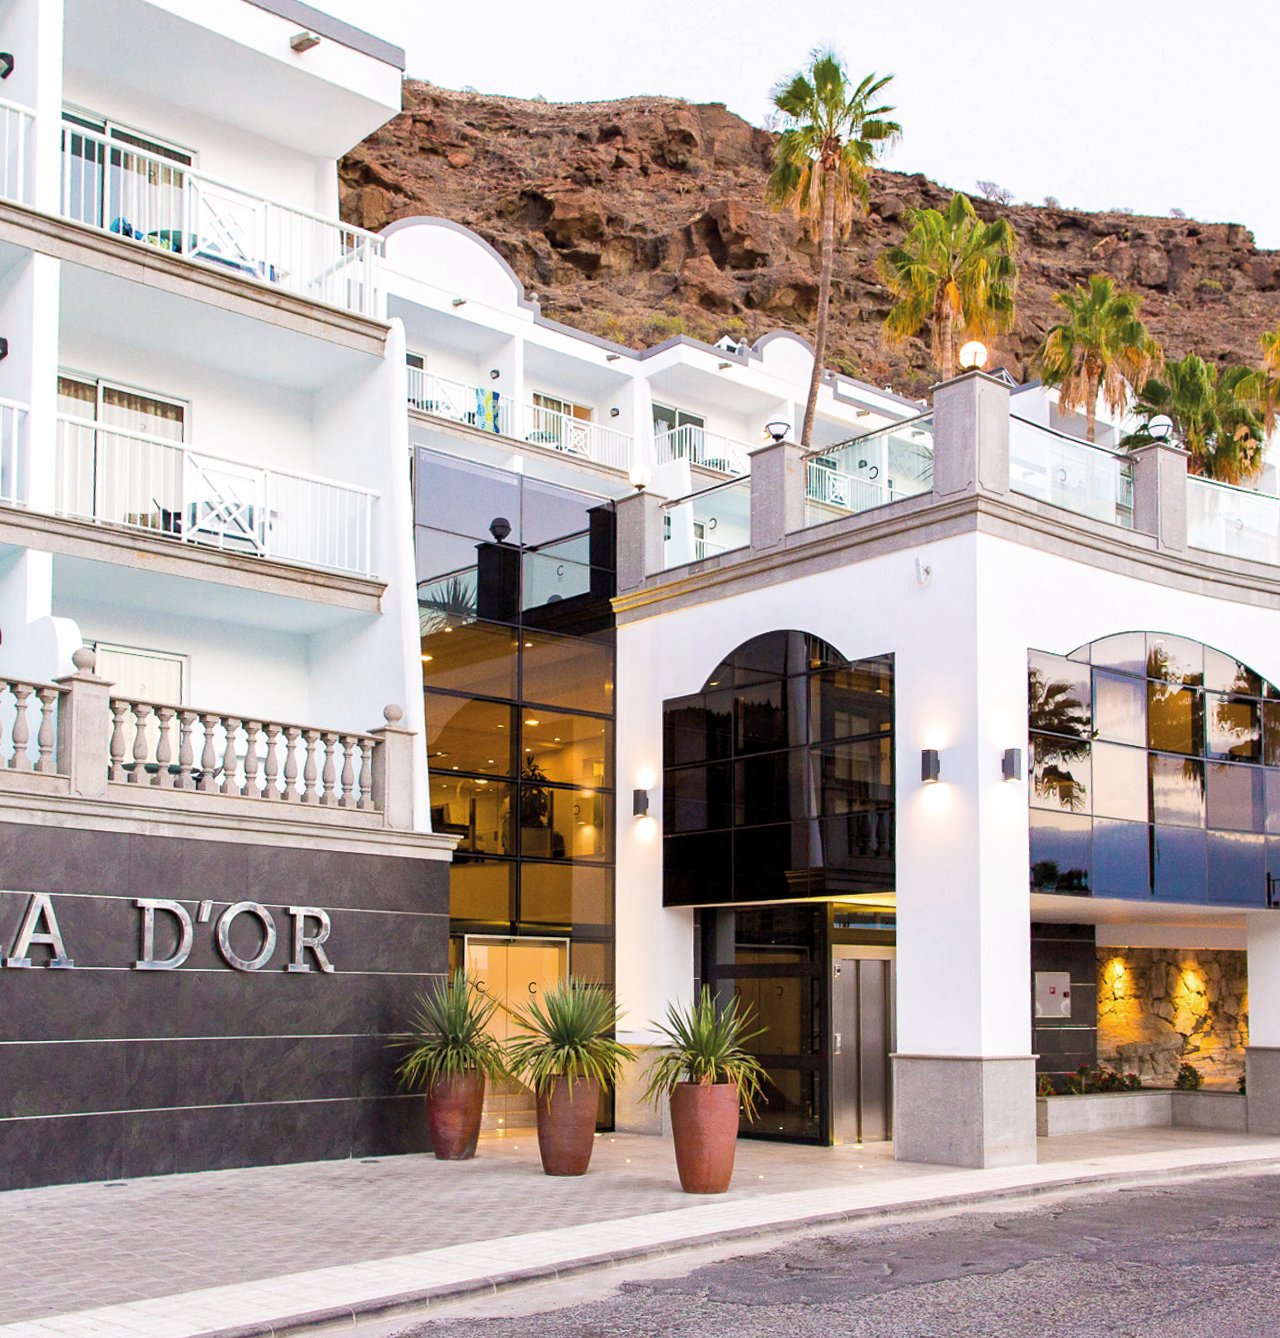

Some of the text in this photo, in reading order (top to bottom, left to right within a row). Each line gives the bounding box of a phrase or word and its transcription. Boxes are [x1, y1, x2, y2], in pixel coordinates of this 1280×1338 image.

[556, 564, 564, 577] C
[132, 898, 336, 974] D'OR
[475, 980, 486, 994] C
[528, 981, 537, 994] C
